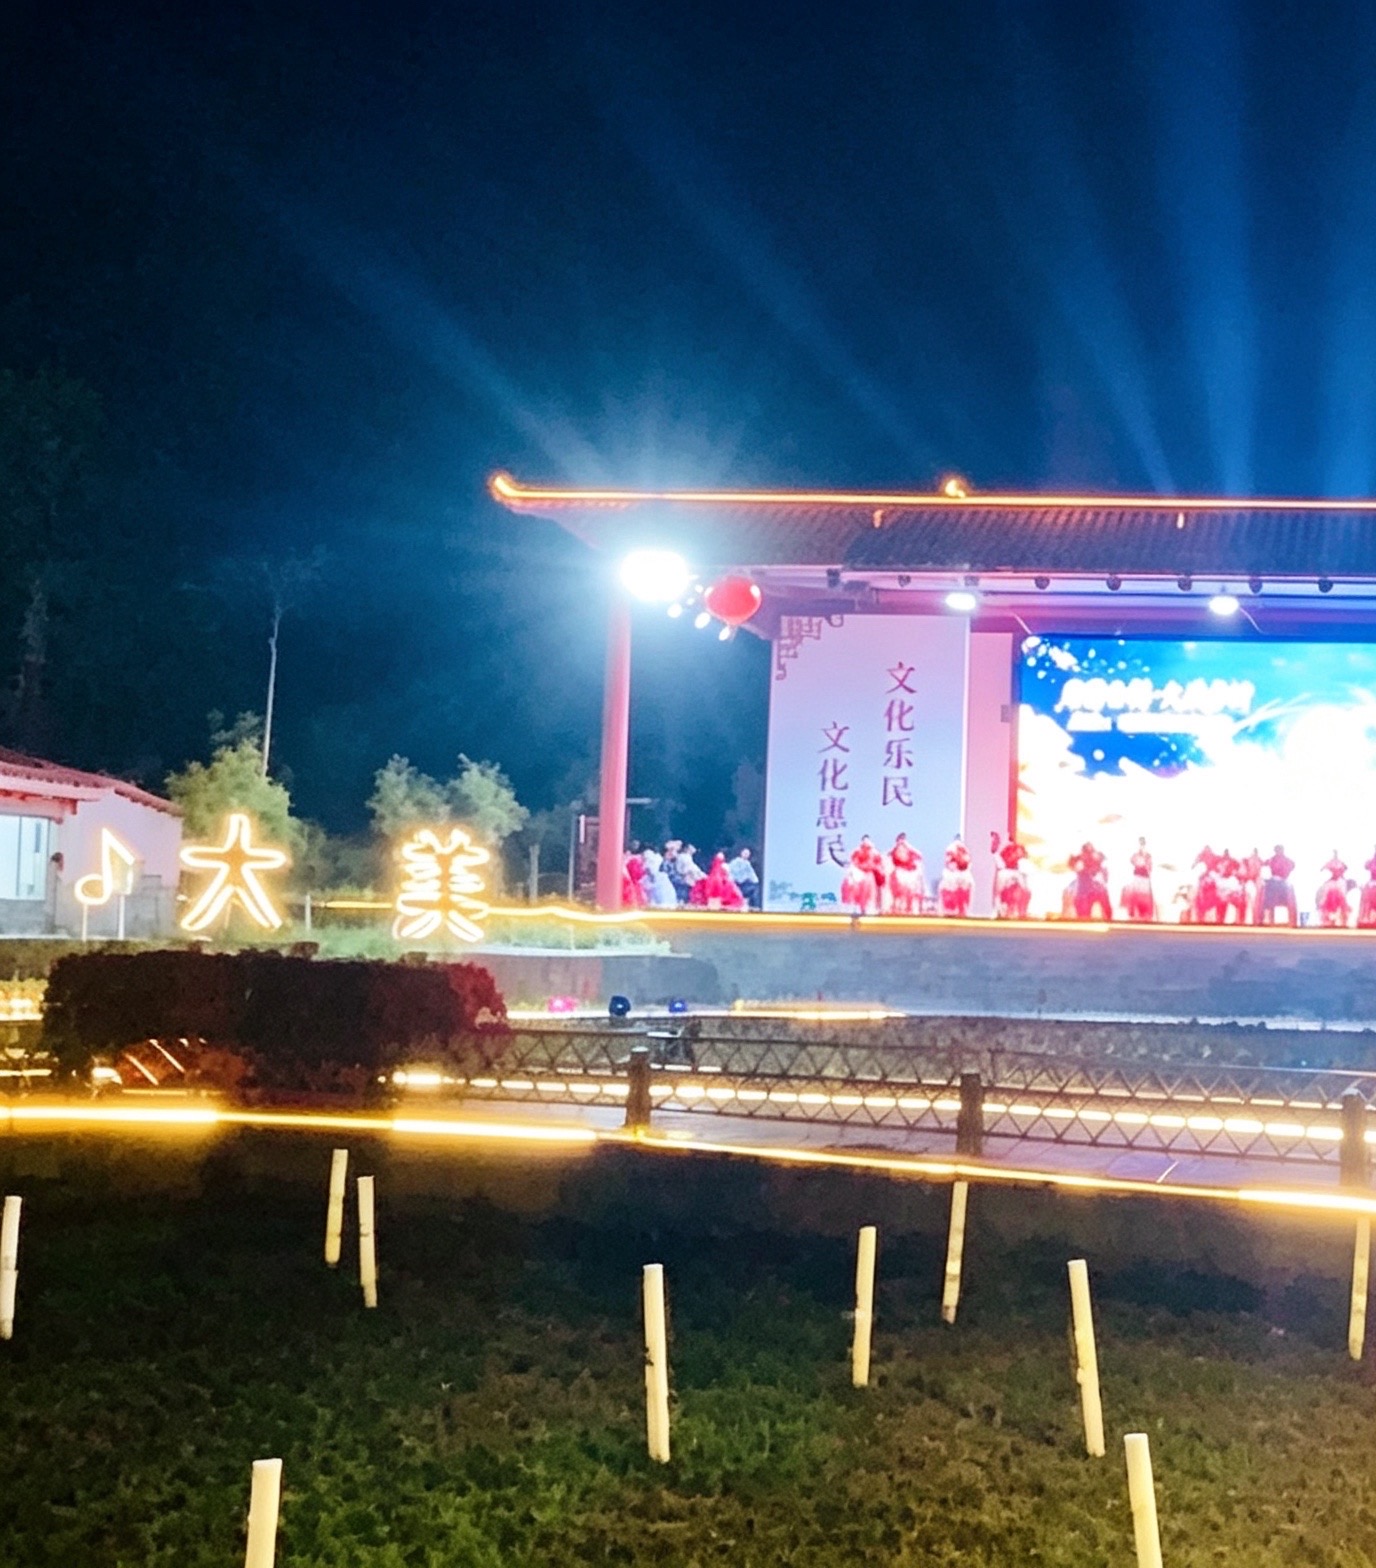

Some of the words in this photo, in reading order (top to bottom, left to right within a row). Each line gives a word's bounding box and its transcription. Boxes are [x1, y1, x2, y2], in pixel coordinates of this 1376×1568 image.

[816, 721, 851, 868] 文化惠民
[882, 661, 918, 807] 文化乐民
